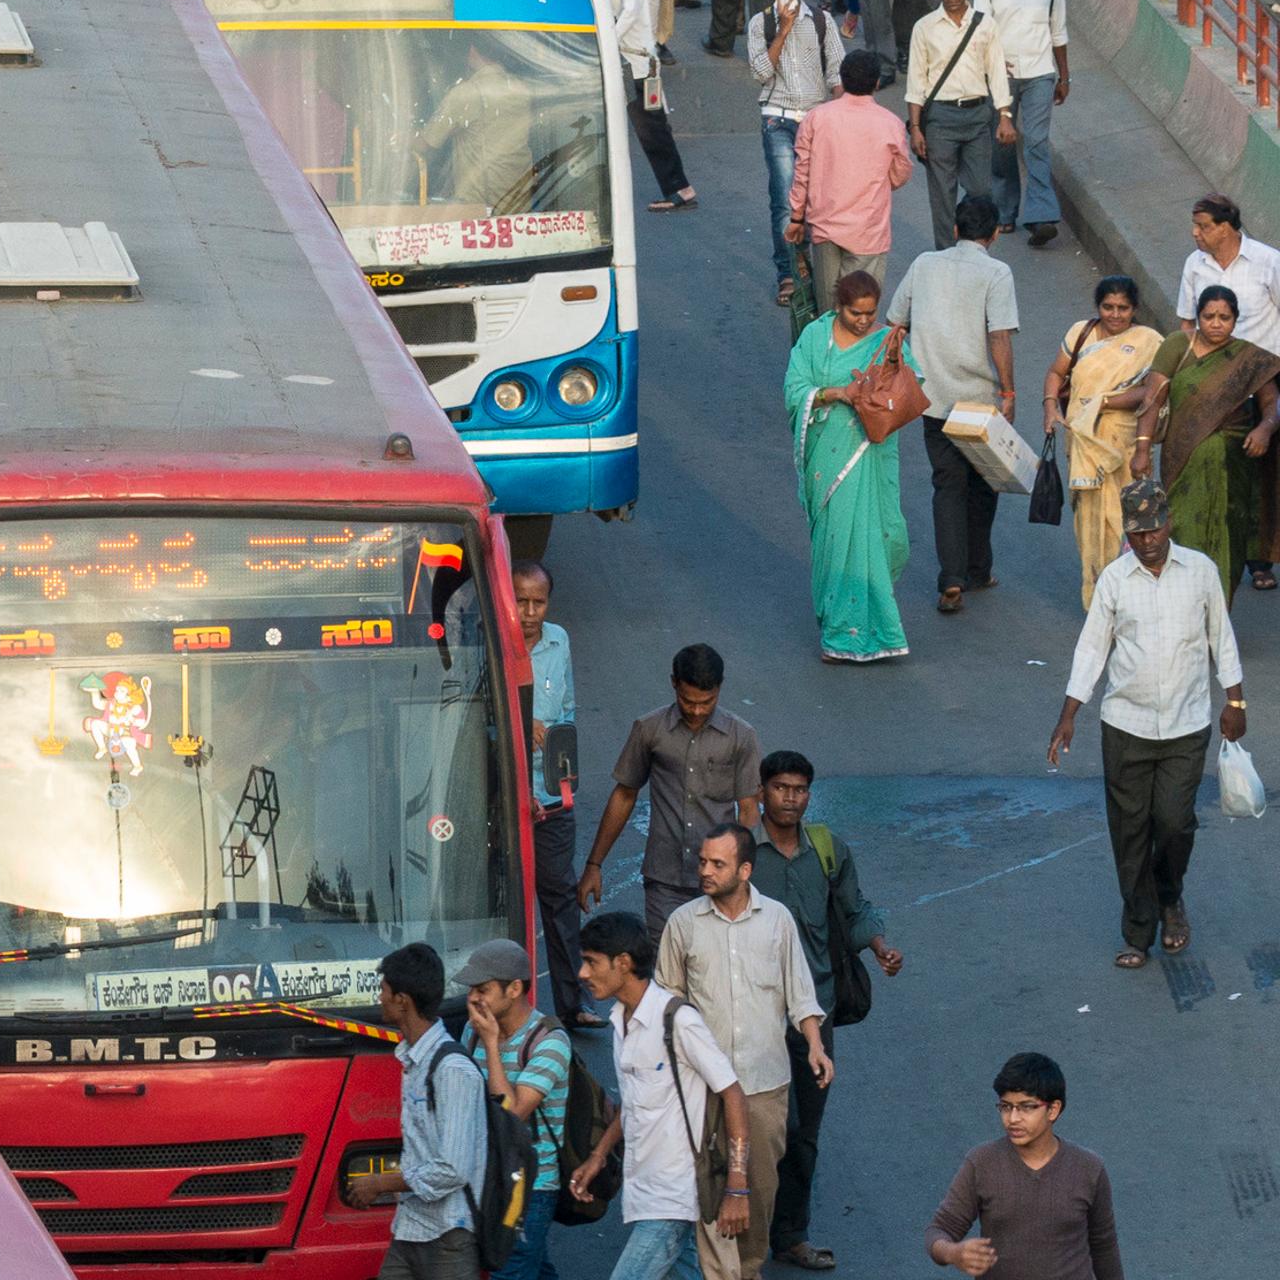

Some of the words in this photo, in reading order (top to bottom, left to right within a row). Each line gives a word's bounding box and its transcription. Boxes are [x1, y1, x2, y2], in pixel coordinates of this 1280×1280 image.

[460, 218, 513, 249] 238
[173, 625, 231, 651] ಸಾ
[321, 620, 393, 648] ಸಂ
[102, 977, 148, 1007] ಕೆಂಪೇಗೌಡ
[153, 975, 173, 1003] ಬಸ್
[178, 974, 207, 1003] ನಿಲ್ದಾಣ
[15, 1035, 217, 1063] B.M.T.C
